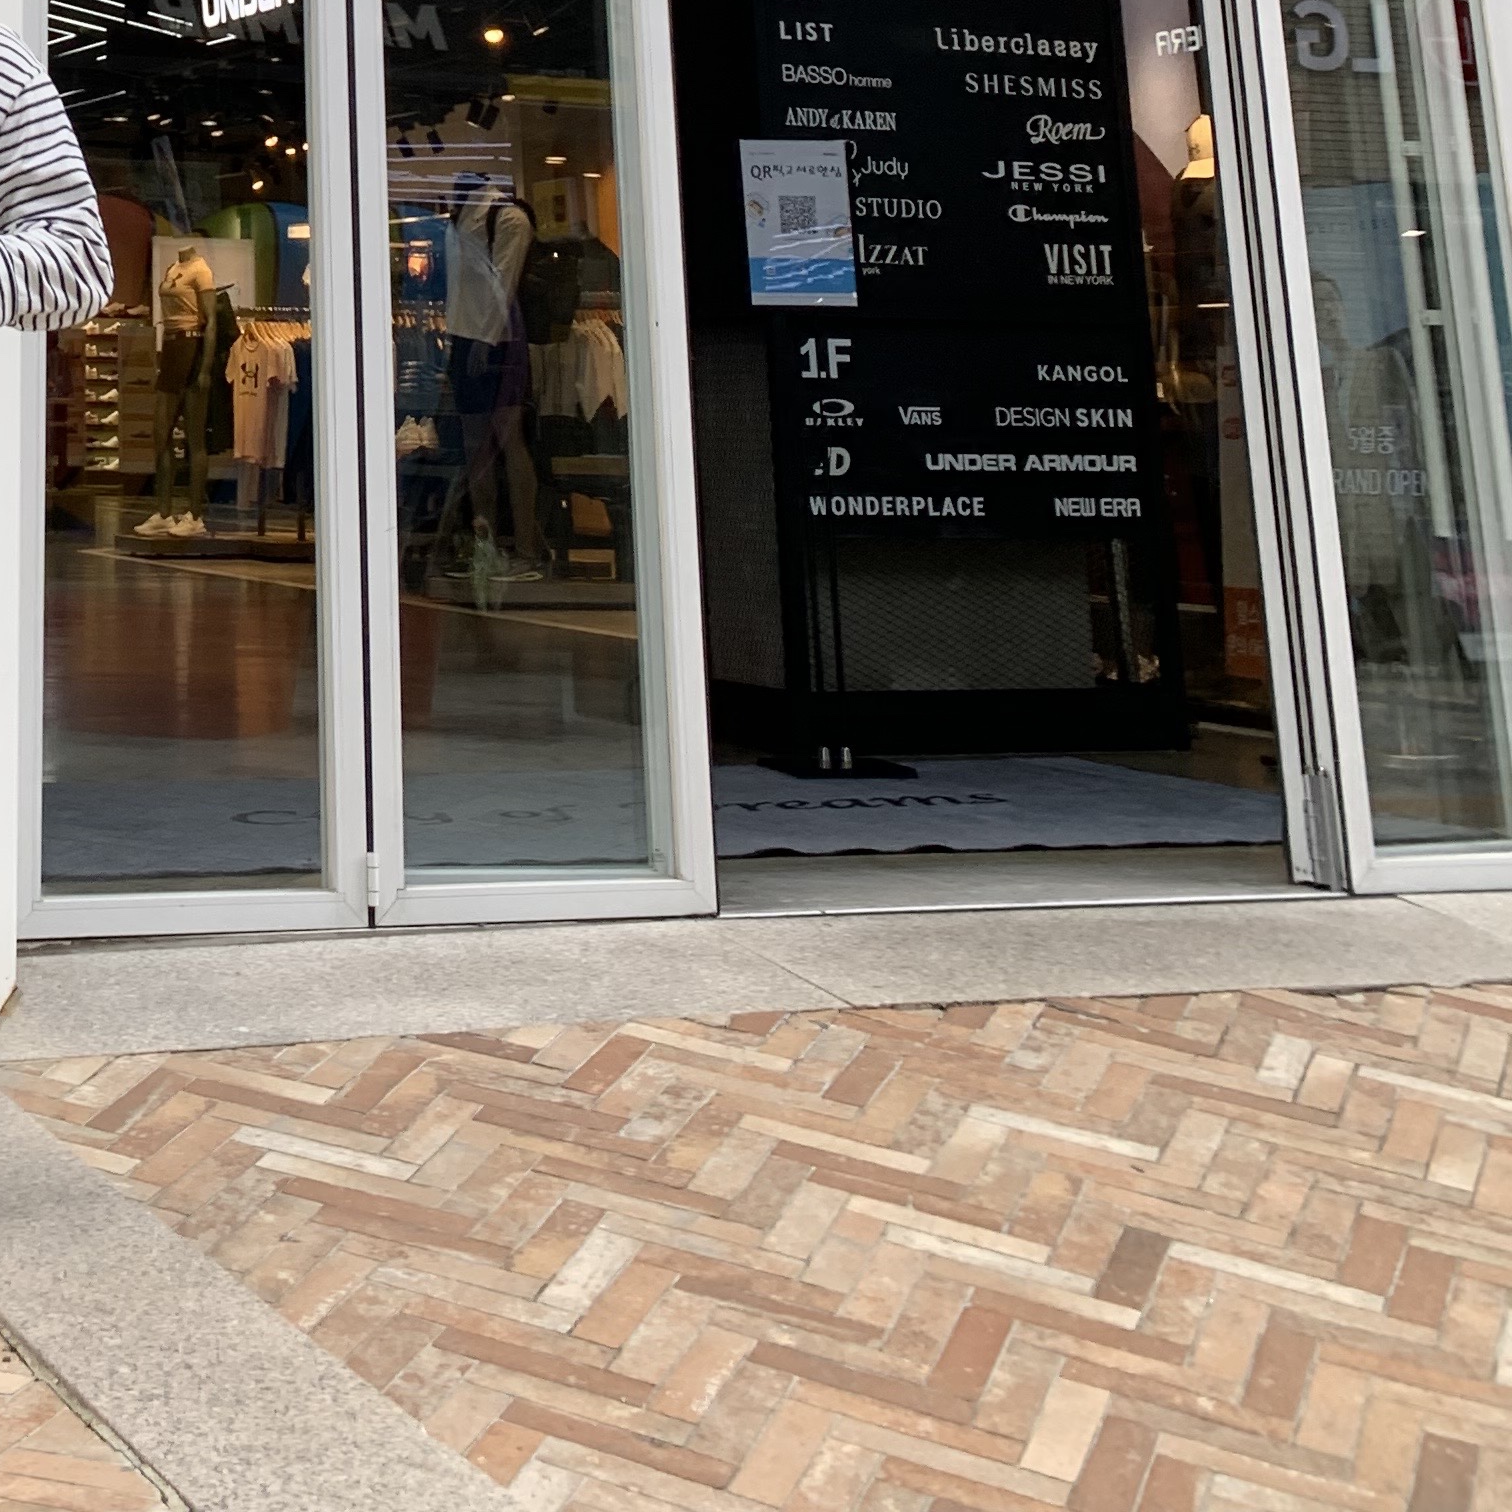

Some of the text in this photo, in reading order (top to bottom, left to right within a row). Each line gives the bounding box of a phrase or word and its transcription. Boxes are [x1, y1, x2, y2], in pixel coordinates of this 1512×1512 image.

[779, 21, 834, 43] LIST
[781, 64, 893, 89] BASSO homme
[965, 73, 1103, 101] SHESMISS
[785, 107, 829, 129] ANDY
[841, 109, 897, 131] KAREN
[860, 156, 909, 182] Judy
[982, 160, 1106, 183] JESSI
[1011, 181, 1094, 194] NEW YORK
[855, 197, 943, 220] STUDIO
[1007, 203, 1109, 229] Champion
[1043, 243, 1112, 275] VISIT
[1060, 275, 1084, 285] NEW
[1084, 275, 1114, 286] YORK
[1037, 364, 1129, 384] KANGOL
[898, 406, 943, 426] VANS
[995, 407, 1133, 428] DESIGN SKIN
[925, 453, 1137, 473] UNDER ARMOUR
[809, 495, 986, 517] WONDERPLACE
[1054, 496, 1141, 518] NEW ERA
